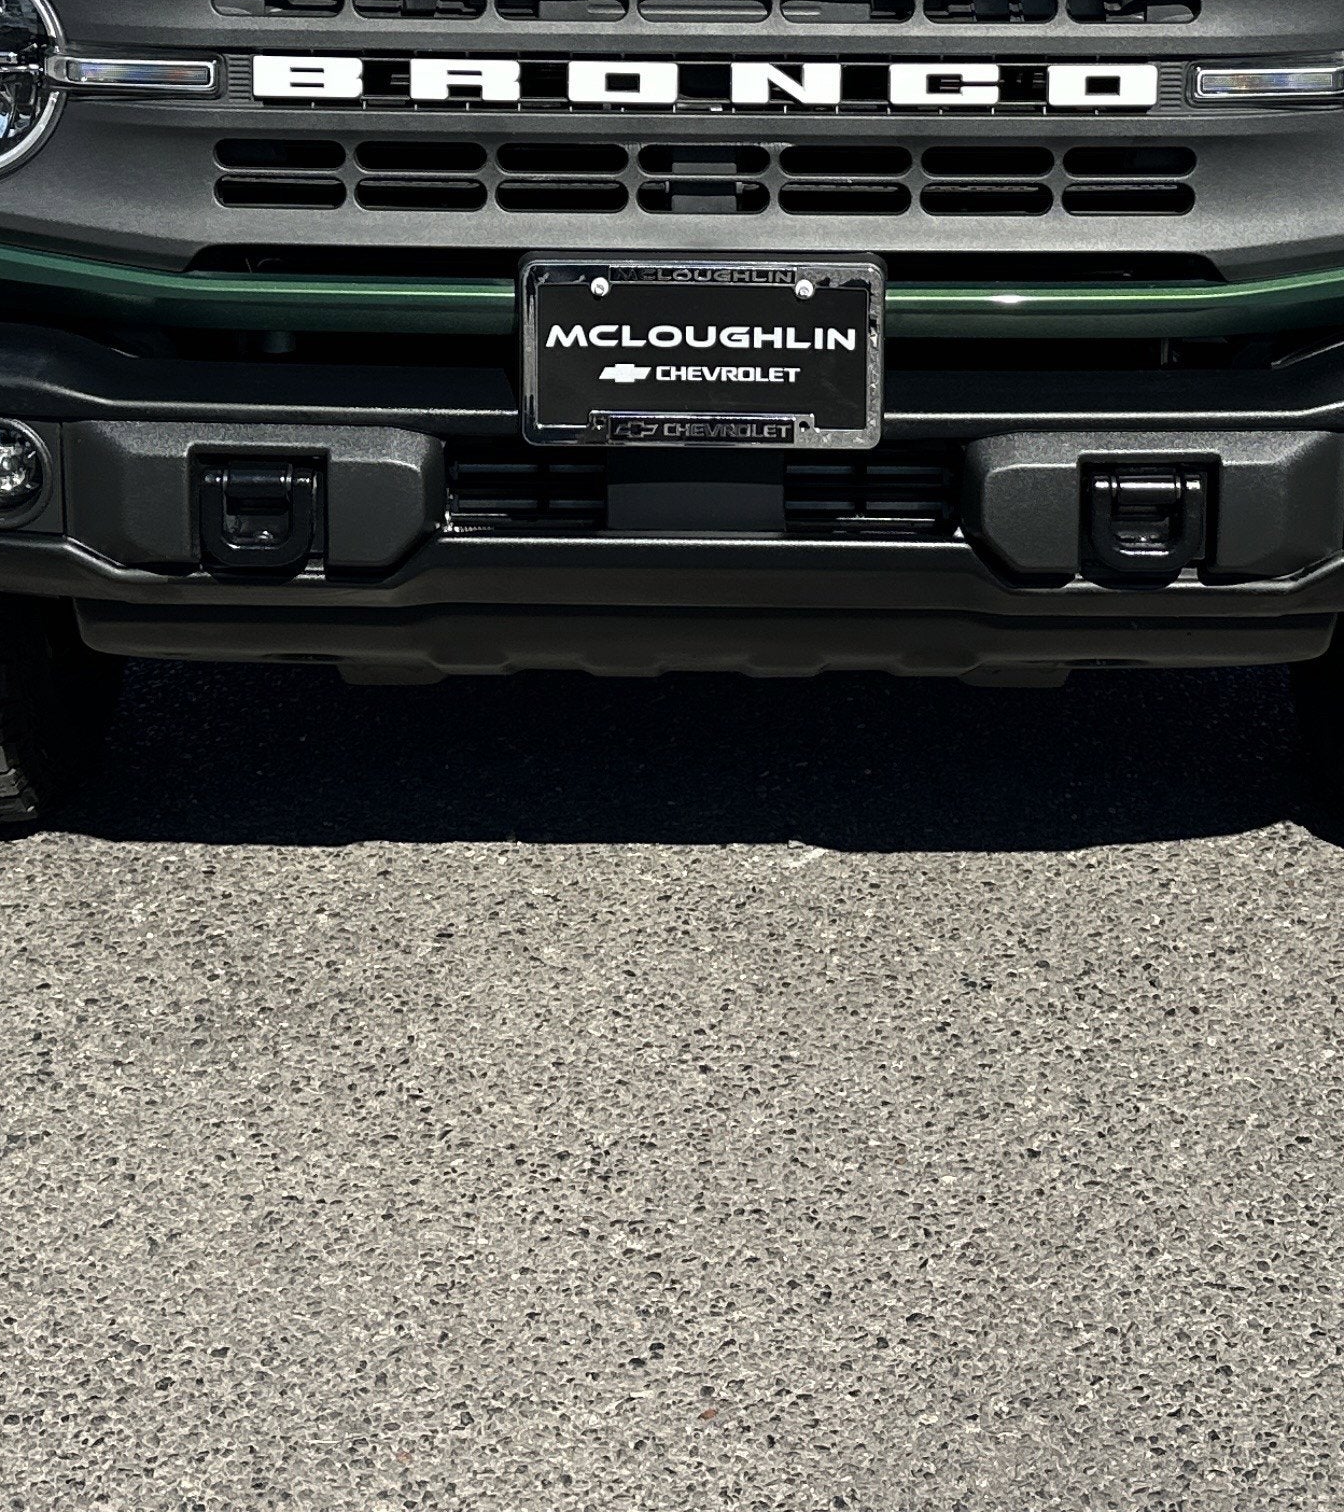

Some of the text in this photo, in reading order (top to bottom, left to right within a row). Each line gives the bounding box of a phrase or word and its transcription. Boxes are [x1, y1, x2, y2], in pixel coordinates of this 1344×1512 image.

[253, 55, 1157, 106] BRONCO
[615, 267, 793, 284] MCLOUGHLIN
[545, 324, 856, 351] MCLOUGHLIN
[656, 365, 801, 383] CHEVROLET
[663, 422, 792, 439] CHEVROLET
